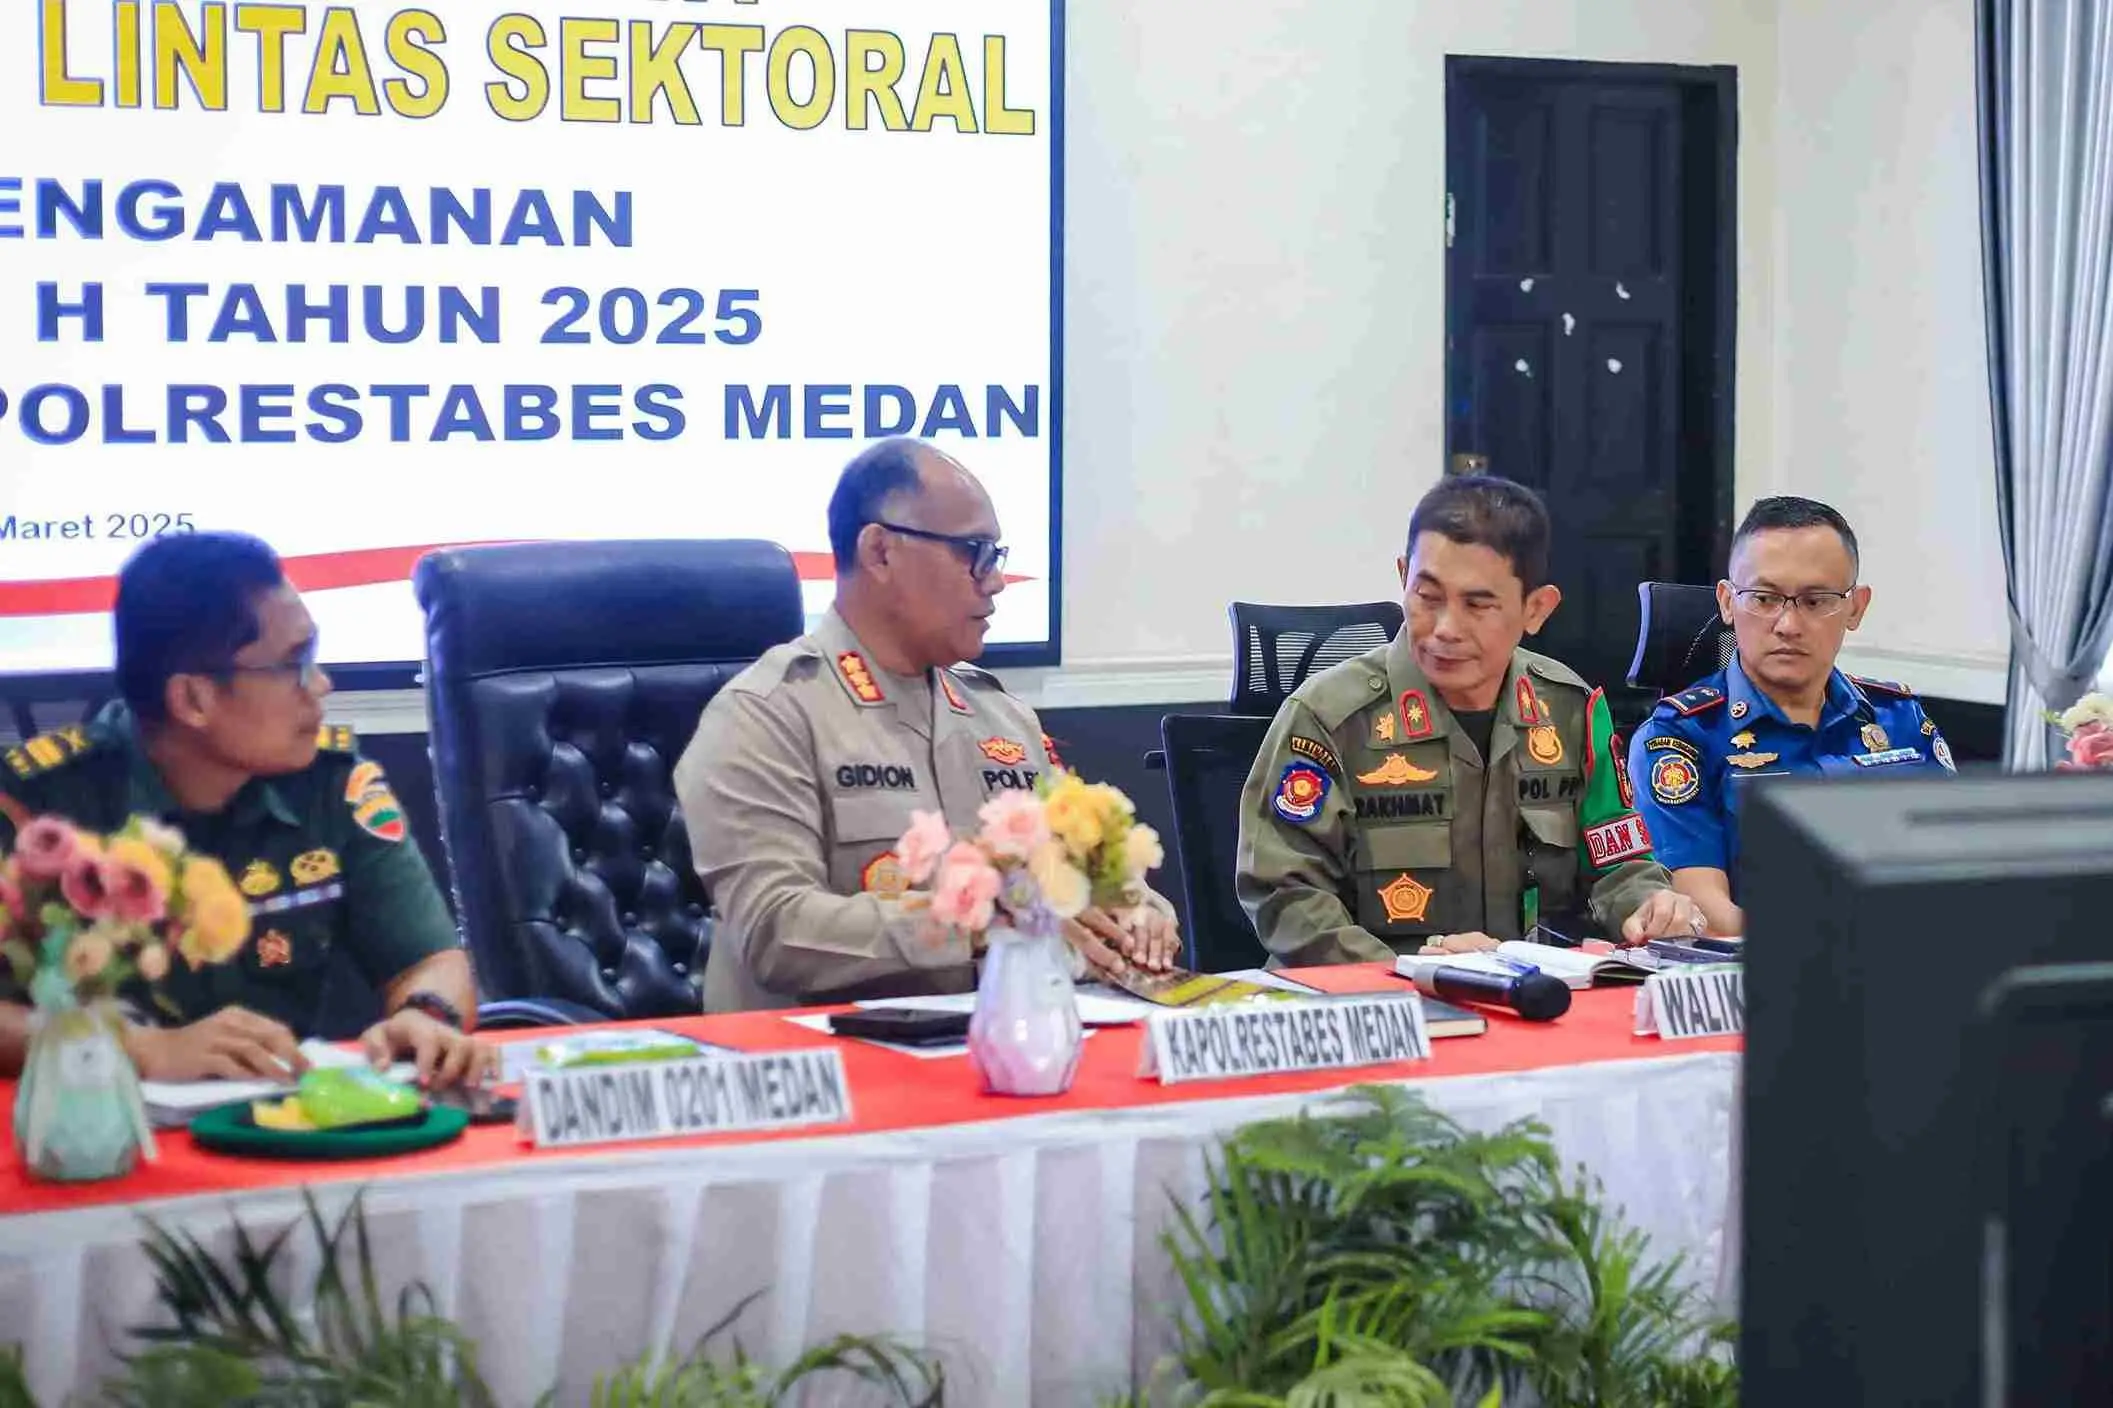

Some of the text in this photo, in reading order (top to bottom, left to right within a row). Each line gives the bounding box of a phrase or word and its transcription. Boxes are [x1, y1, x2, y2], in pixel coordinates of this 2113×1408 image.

[38, 0, 1036, 136] LINTAS SEKTORAL
[36, 281, 763, 346] H TAHUN 2025
[0, 383, 1040, 445] OLRESTABES MEDAN
[106, 512, 195, 539] 2025
[835, 765, 915, 788] GIDION
[982, 769, 1040, 792] POLR
[1519, 777, 1551, 800] POL
[1589, 823, 1633, 860] DAN
[1659, 973, 1746, 1036] WALIK
[1165, 1002, 1423, 1076] KAPOLRESTABES MEDAN
[539, 1052, 842, 1139] DANDIM 0201 MEDAN
